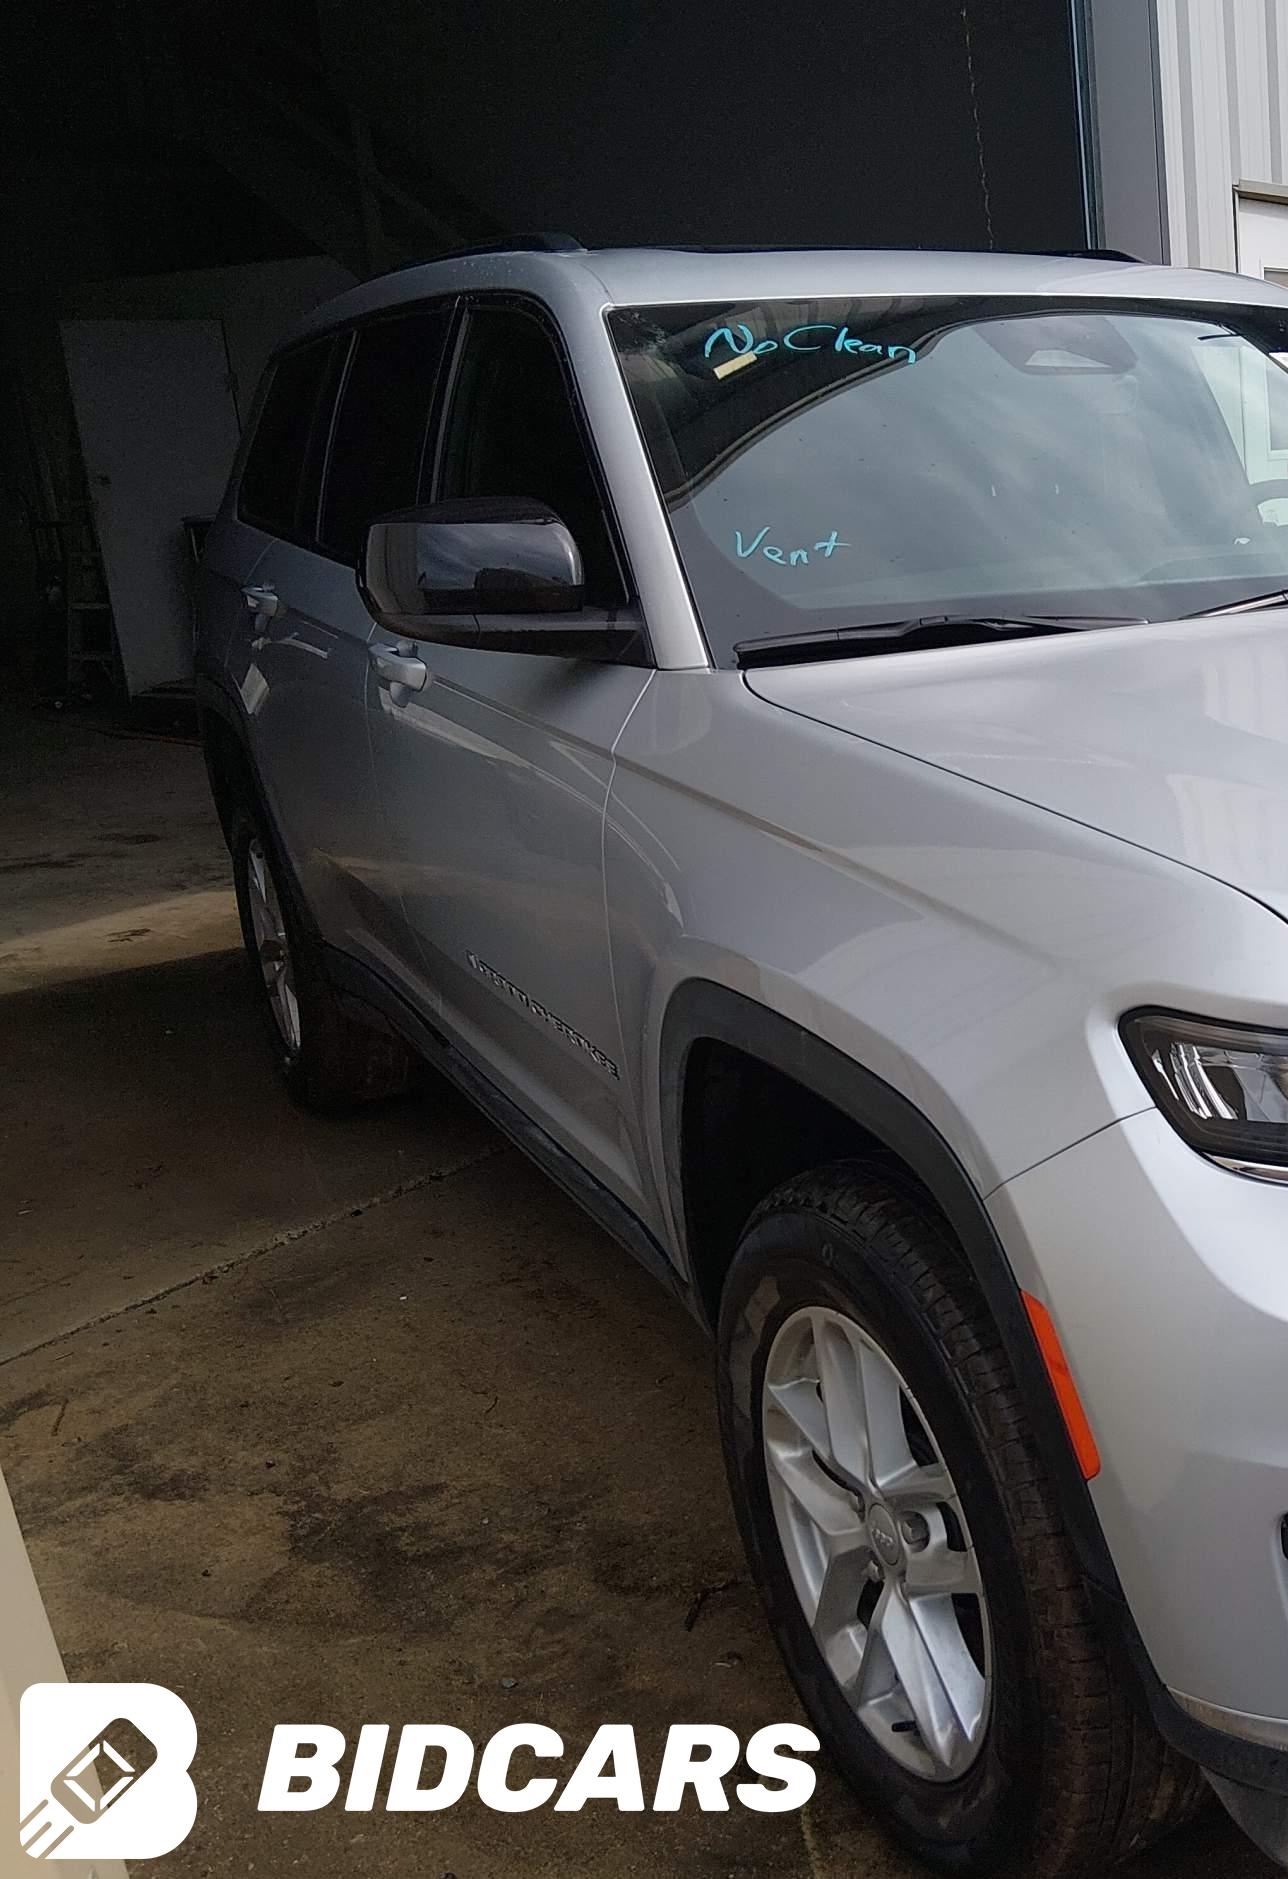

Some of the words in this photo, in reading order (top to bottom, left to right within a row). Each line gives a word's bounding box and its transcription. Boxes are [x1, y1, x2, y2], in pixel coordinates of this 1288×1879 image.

[704, 323, 778, 358] No
[783, 324, 917, 365] Clean
[735, 526, 852, 566] Vent
